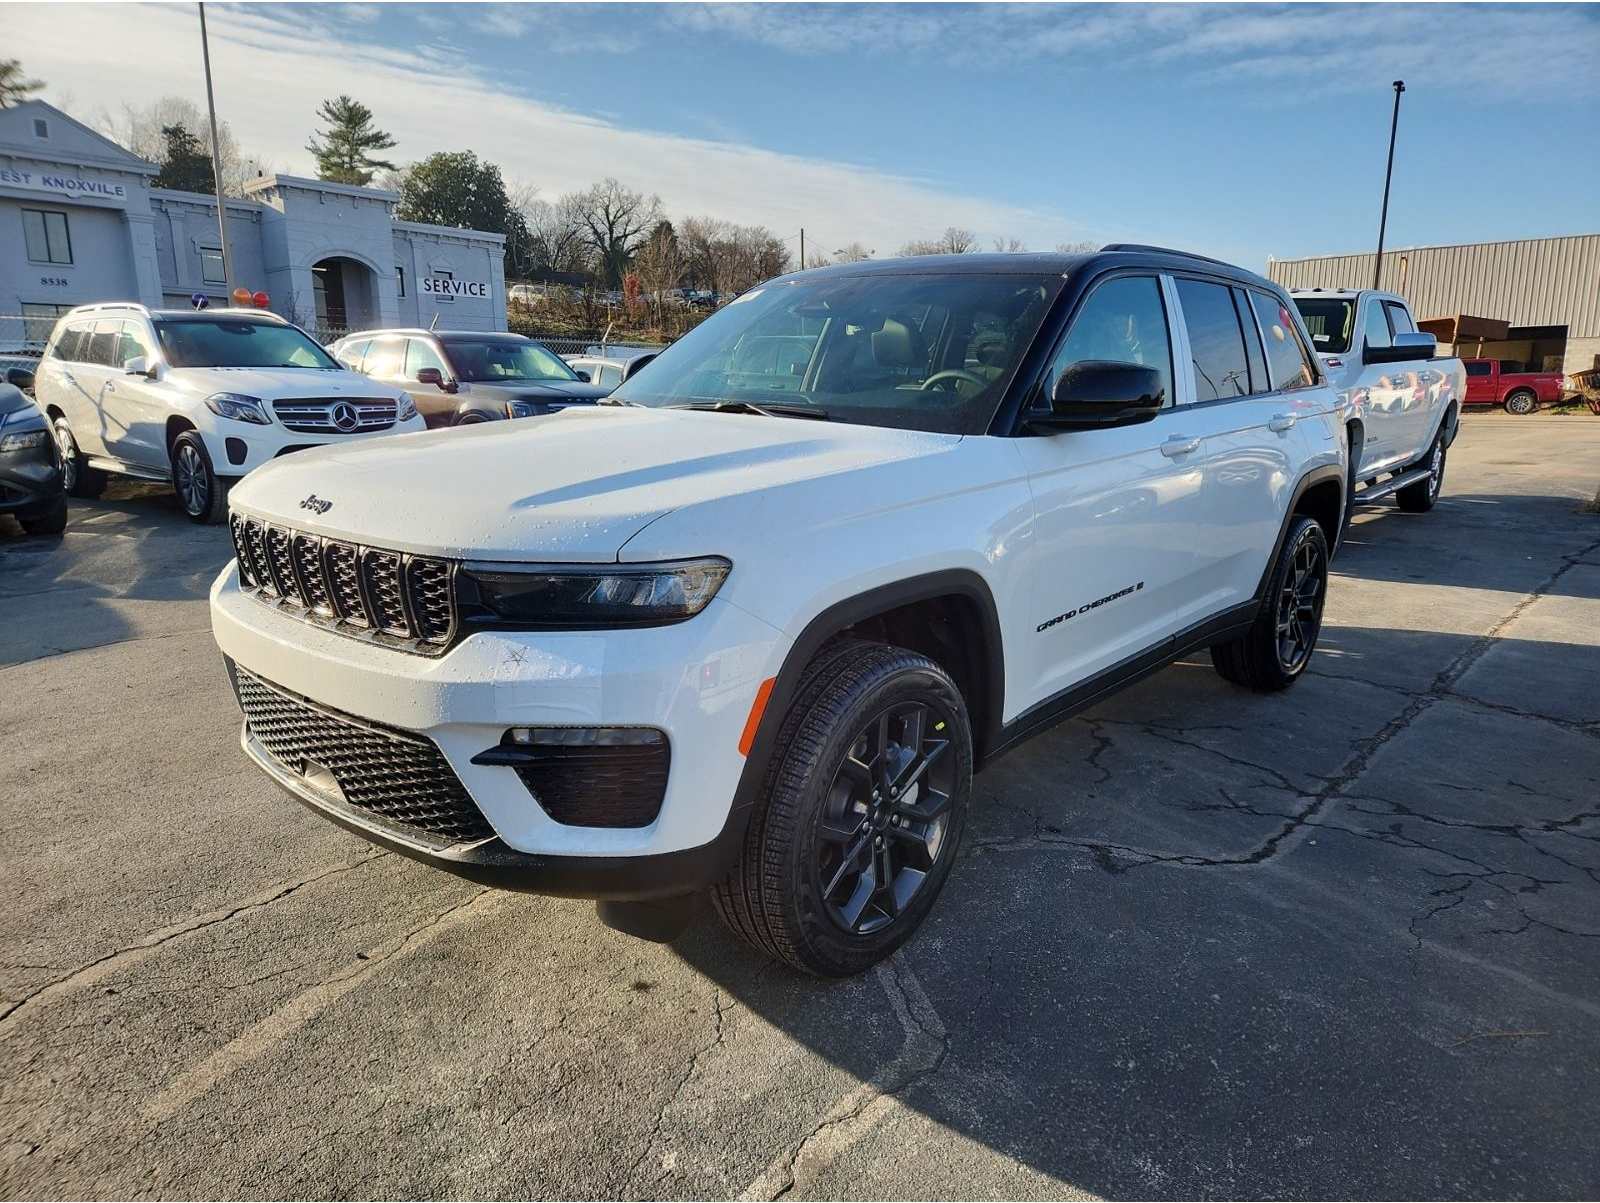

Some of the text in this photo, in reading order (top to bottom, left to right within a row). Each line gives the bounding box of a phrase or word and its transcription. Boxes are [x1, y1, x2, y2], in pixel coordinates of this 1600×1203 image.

[424, 278, 486, 296] SERVICE
[300, 495, 333, 515] Jeep
[1037, 585, 1135, 632] GRAND CHEROKEE
